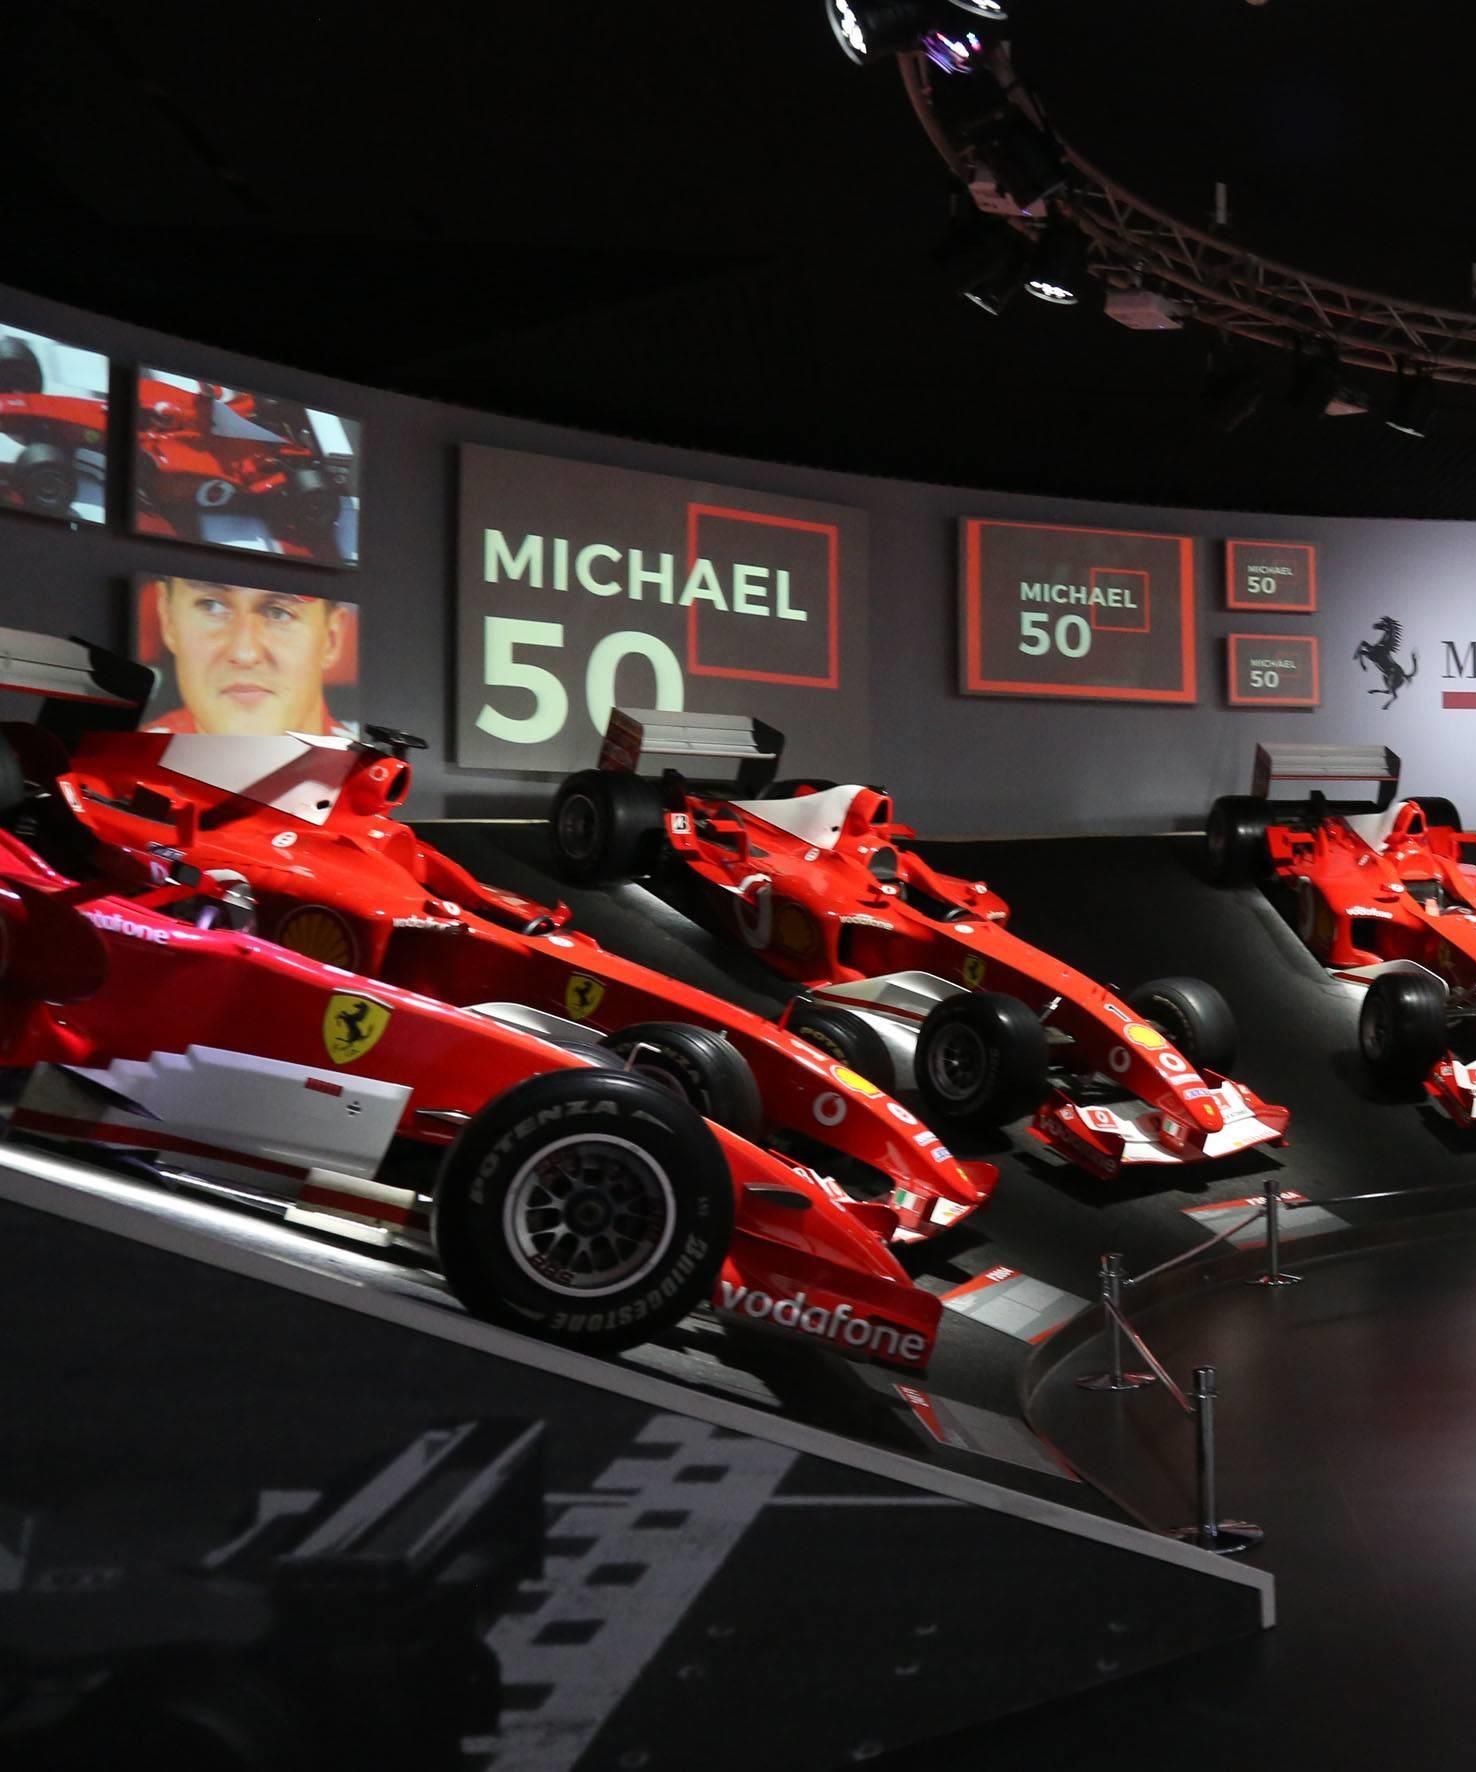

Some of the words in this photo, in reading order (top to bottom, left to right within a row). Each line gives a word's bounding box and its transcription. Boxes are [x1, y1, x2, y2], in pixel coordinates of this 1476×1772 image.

[484, 529, 807, 622] MICHAEL
[1247, 575, 1277, 594] 50
[1248, 565, 1294, 576] MICHAEL
[1020, 581, 1138, 609] MICHAEL
[1018, 611, 1092, 658] 50
[477, 616, 685, 744] 50
[1250, 670, 1280, 688] 50
[1103, 1002, 1132, 1023] 1
[468, 1099, 620, 1206] POTENZA
[541, 1231, 709, 1333] BRIDGESTONE
[721, 1279, 926, 1361] vodafone
